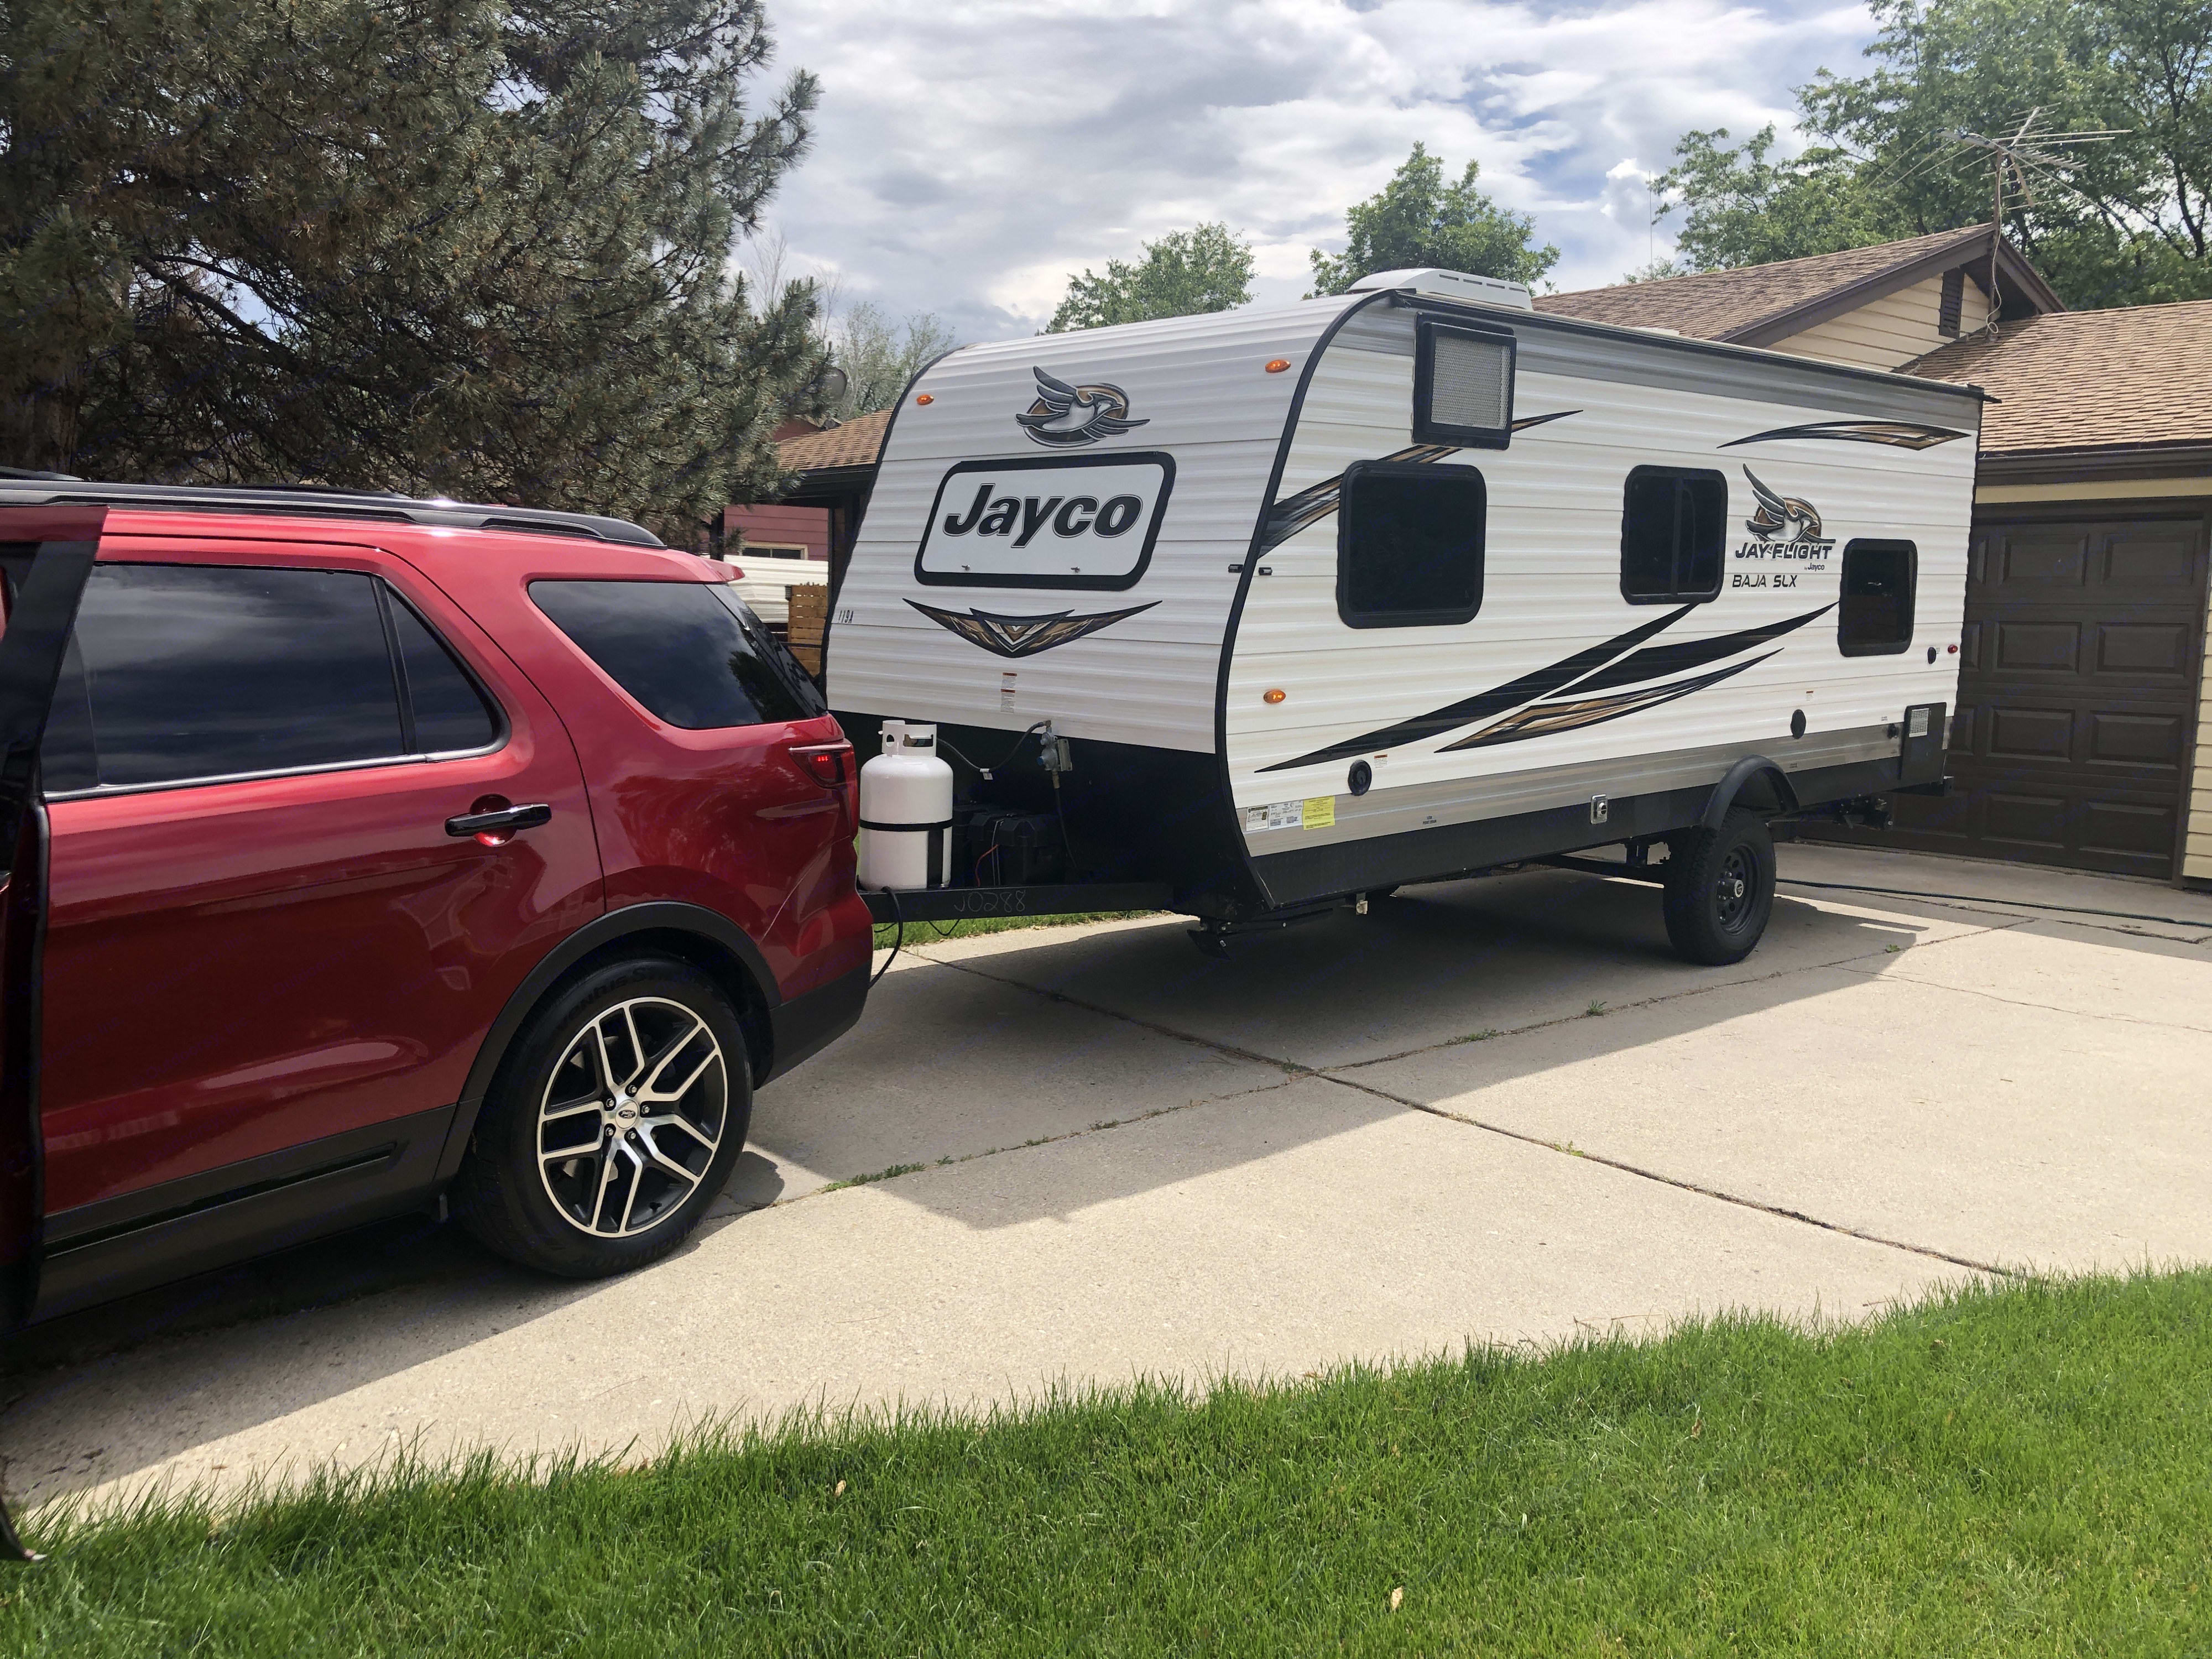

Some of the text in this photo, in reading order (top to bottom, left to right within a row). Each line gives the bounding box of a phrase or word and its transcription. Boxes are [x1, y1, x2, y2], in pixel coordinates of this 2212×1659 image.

[942, 483, 1144, 549] Jayco
[1772, 543, 1833, 560] FLIGHT
[1807, 562, 1825, 572] Jayco
[1732, 575, 1798, 588] BAJA SLX
